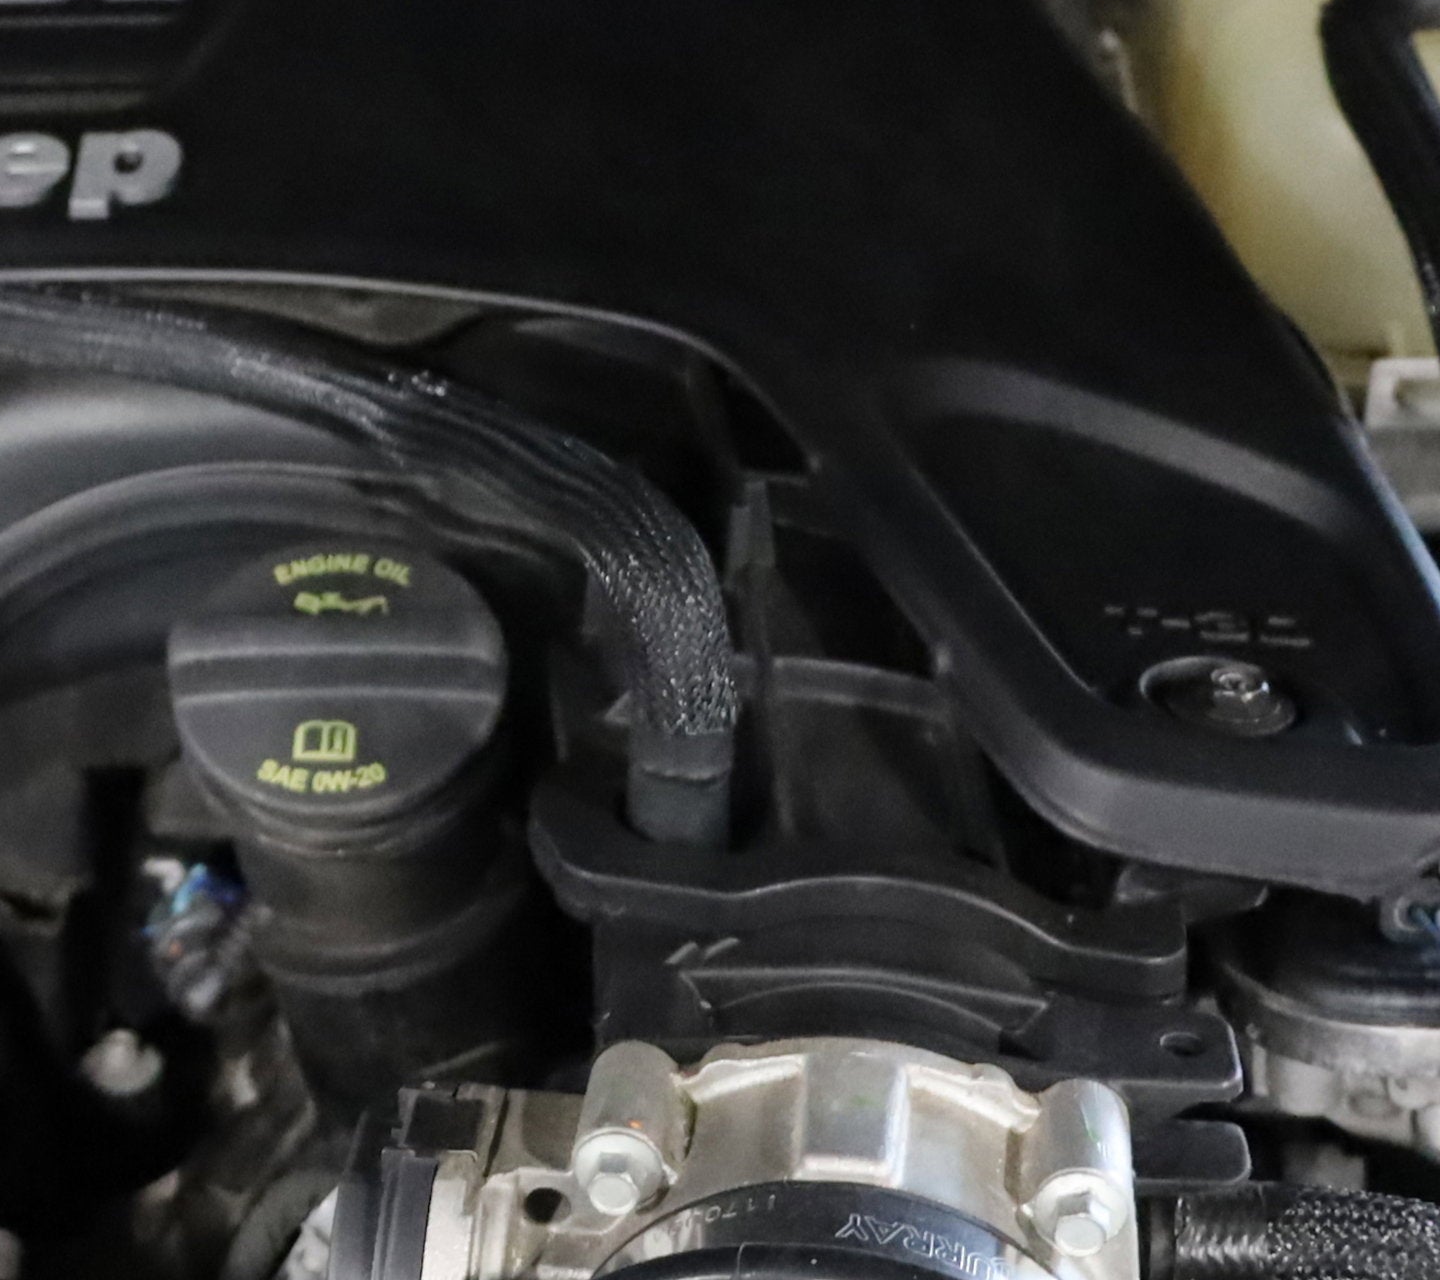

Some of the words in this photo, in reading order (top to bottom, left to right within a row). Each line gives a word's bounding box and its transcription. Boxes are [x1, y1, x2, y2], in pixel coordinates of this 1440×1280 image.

[273, 553, 370, 586] ENGINE
[373, 557, 410, 588] OIL
[256, 758, 309, 793] SAE
[310, 762, 387, 794] 0W-20
